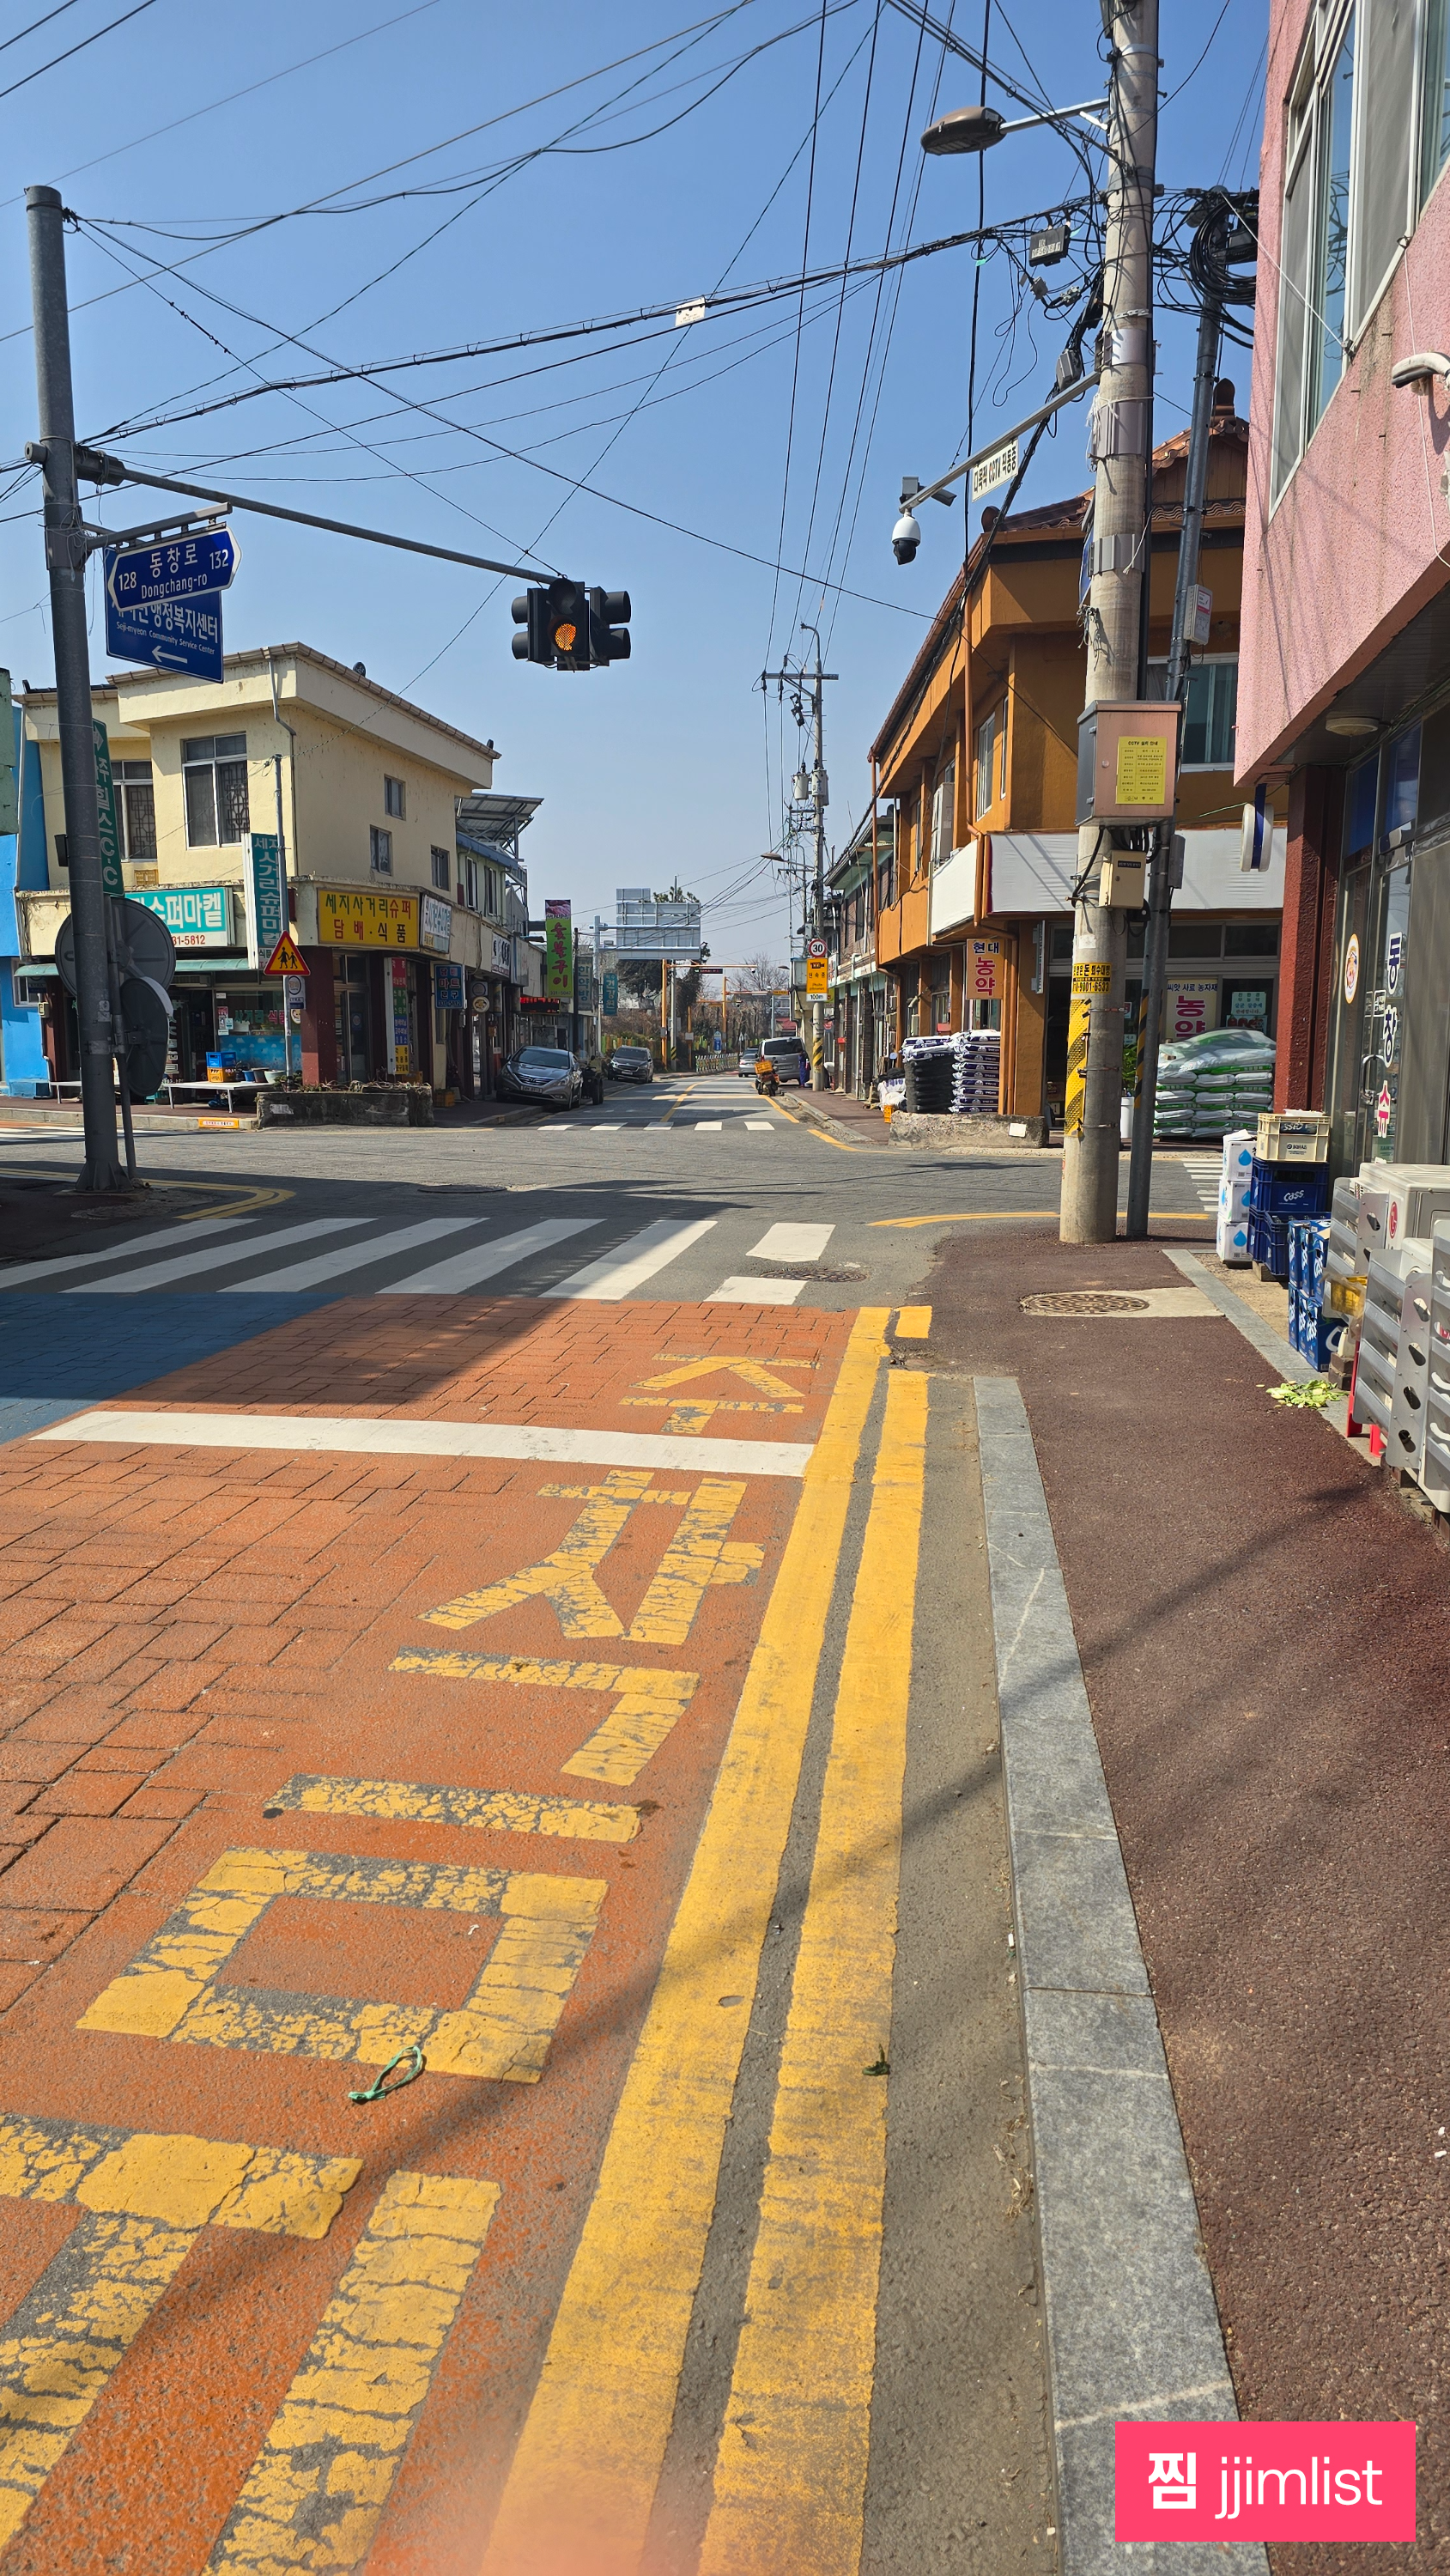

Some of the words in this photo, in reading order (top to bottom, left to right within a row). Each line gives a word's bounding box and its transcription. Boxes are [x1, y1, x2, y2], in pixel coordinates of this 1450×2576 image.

[989, 456, 1002, 483] CCTV
[1002, 446, 1016, 475] 작동중
[118, 572, 137, 591] 128
[150, 544, 198, 578] 동창로
[209, 549, 229, 569] 132
[141, 574, 208, 599] Dongchang-ro
[116, 621, 147, 637] Seji-myeon
[149, 629, 179, 647] Community
[179, 638, 197, 650] Service
[198, 643, 215, 654] Center
[333, 919, 364, 941] 담배
[378, 922, 406, 944] 식품
[812, 944, 823, 953] 30
[973, 941, 999, 954] 현대
[439, 978, 460, 990] 마트
[578, 965, 590, 1001] 한약방
[975, 957, 996, 996] 농약
[1167, 983, 1180, 992] 씨앗
[1182, 983, 1196, 992] 사료
[1198, 983, 1218, 993] 농자재
[605, 979, 616, 1009] 건강원
[1283, 1189, 1305, 1202] Cass
